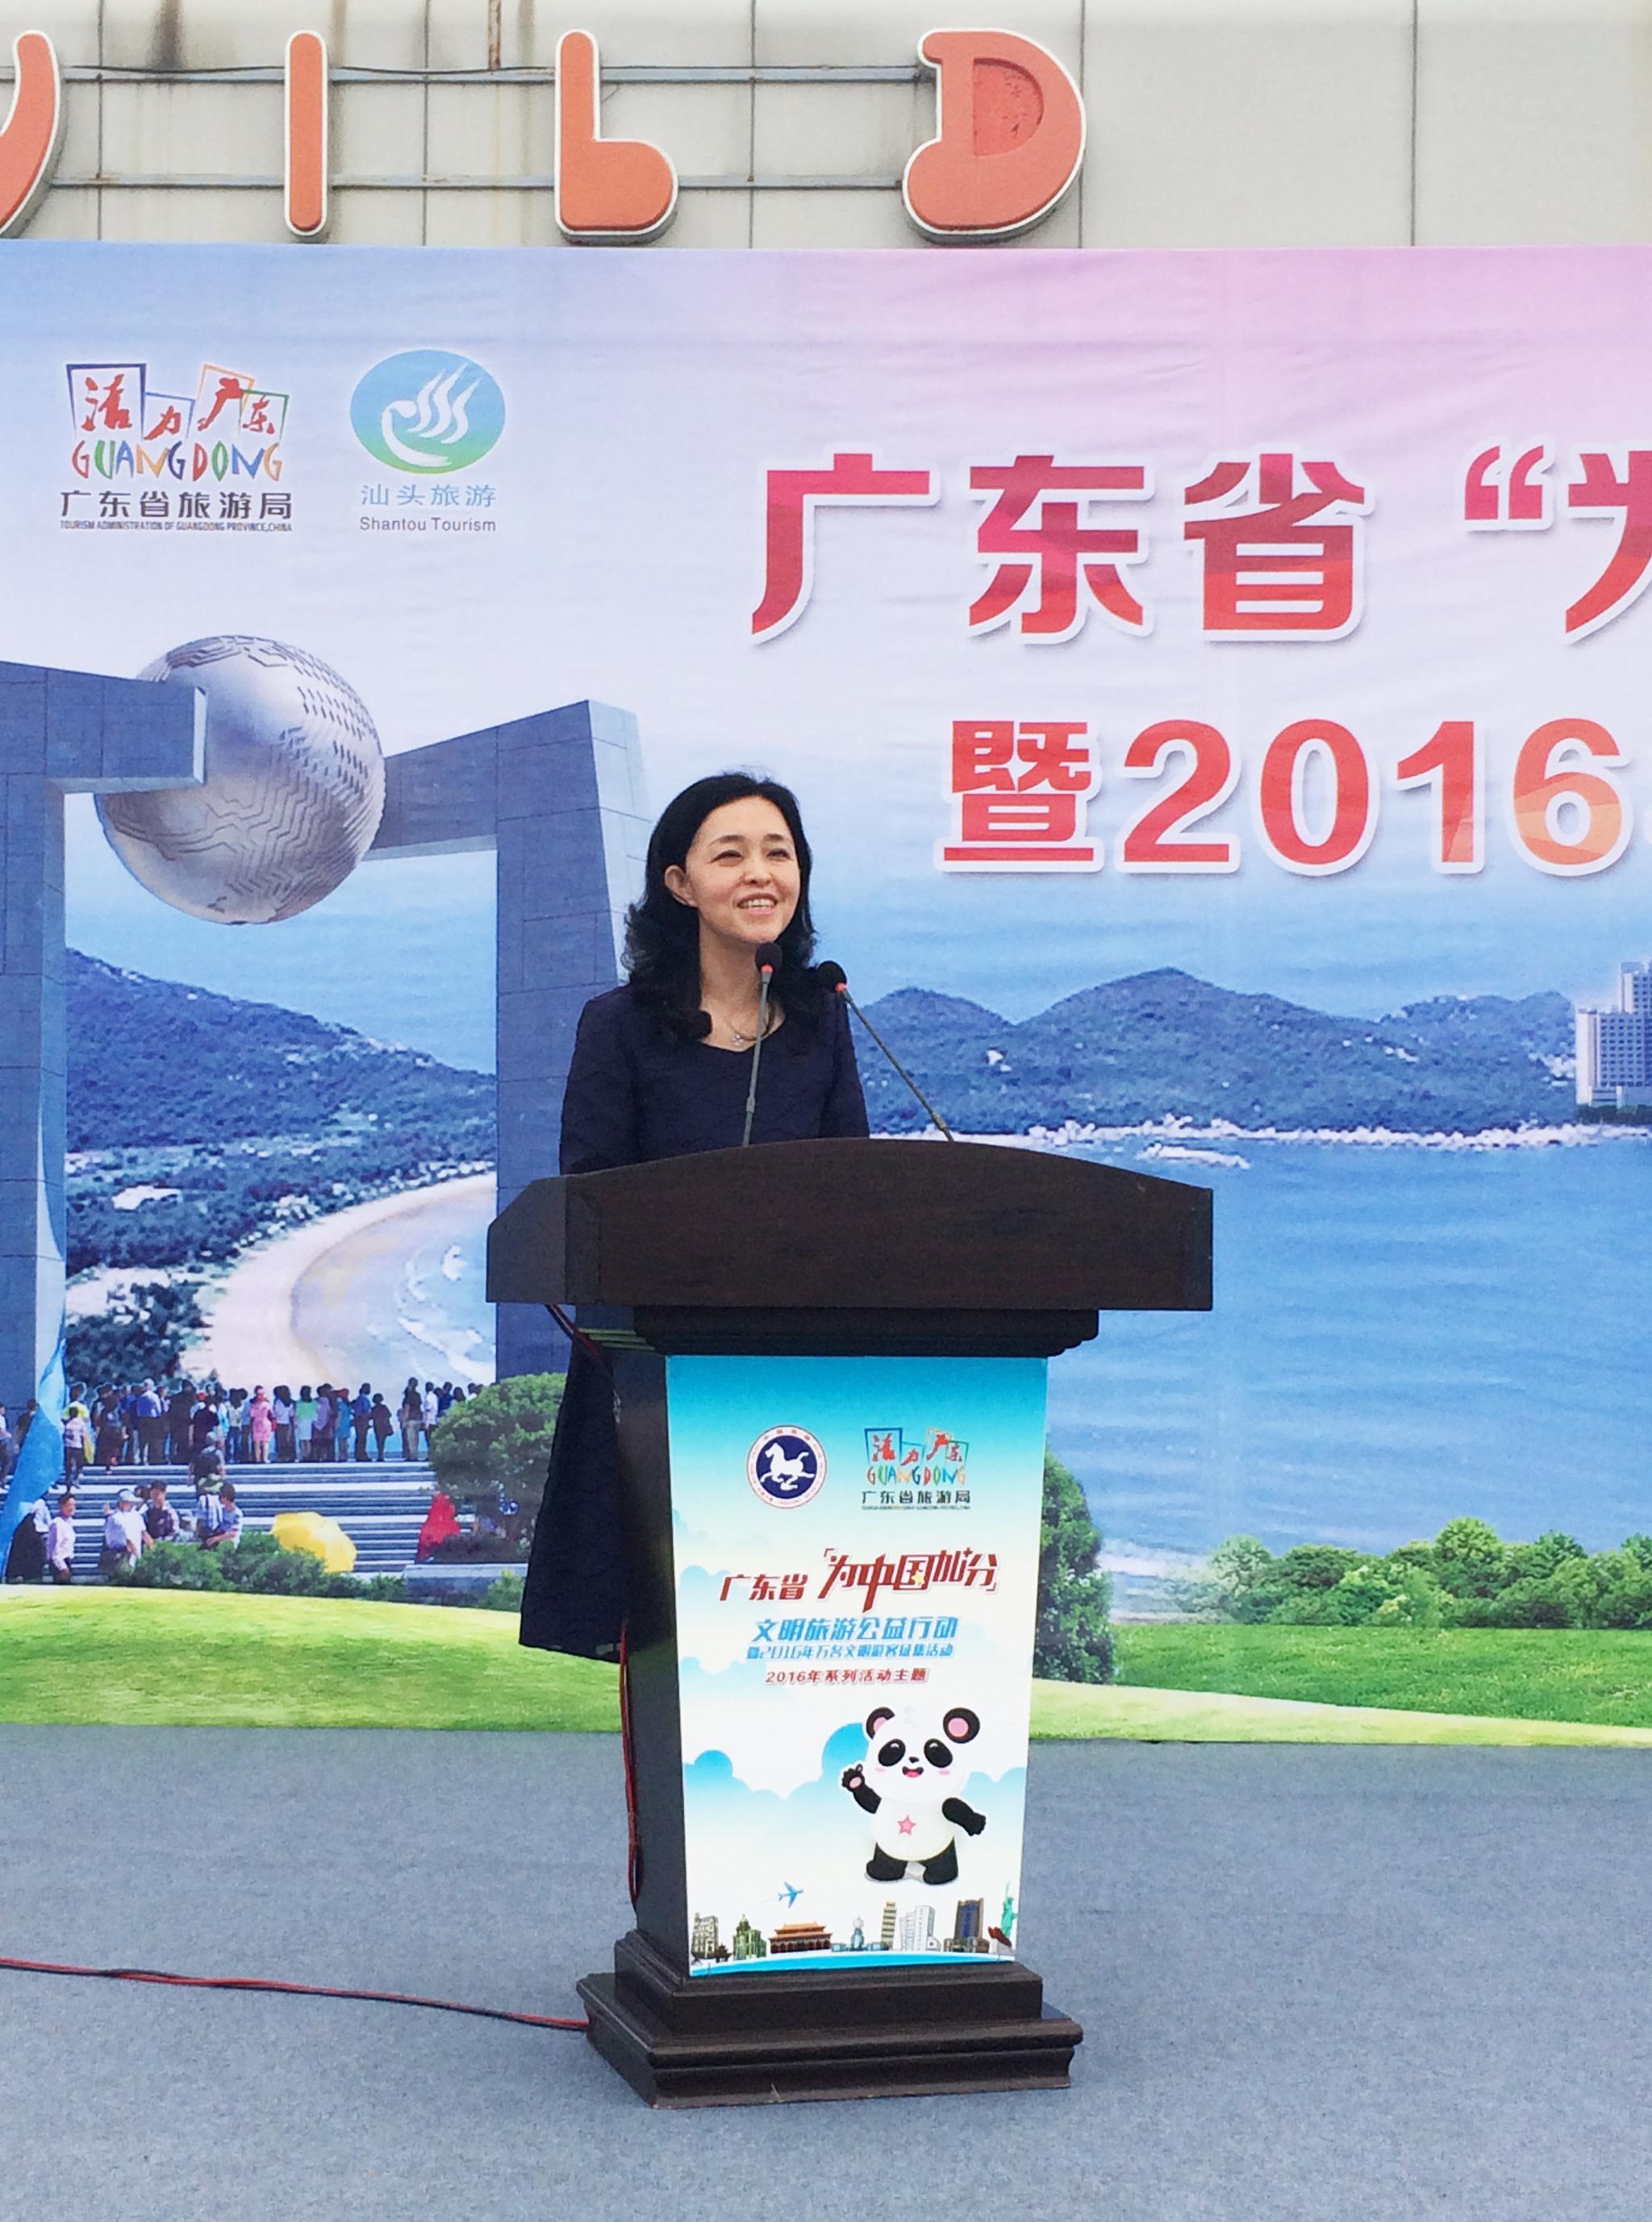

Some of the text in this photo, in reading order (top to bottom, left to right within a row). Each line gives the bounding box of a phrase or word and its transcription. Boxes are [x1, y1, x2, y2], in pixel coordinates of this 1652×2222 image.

[60, 490, 292, 519] 广东省旅游局
[361, 483, 497, 507] 汕头旅游
[360, 516, 496, 532] Shantou Tourism
[943, 718, 1623, 866] 暨2016
[862, 1490, 970, 1504] 广东省旅游局
[751, 1616, 959, 1642] 文明旅游公益行动
